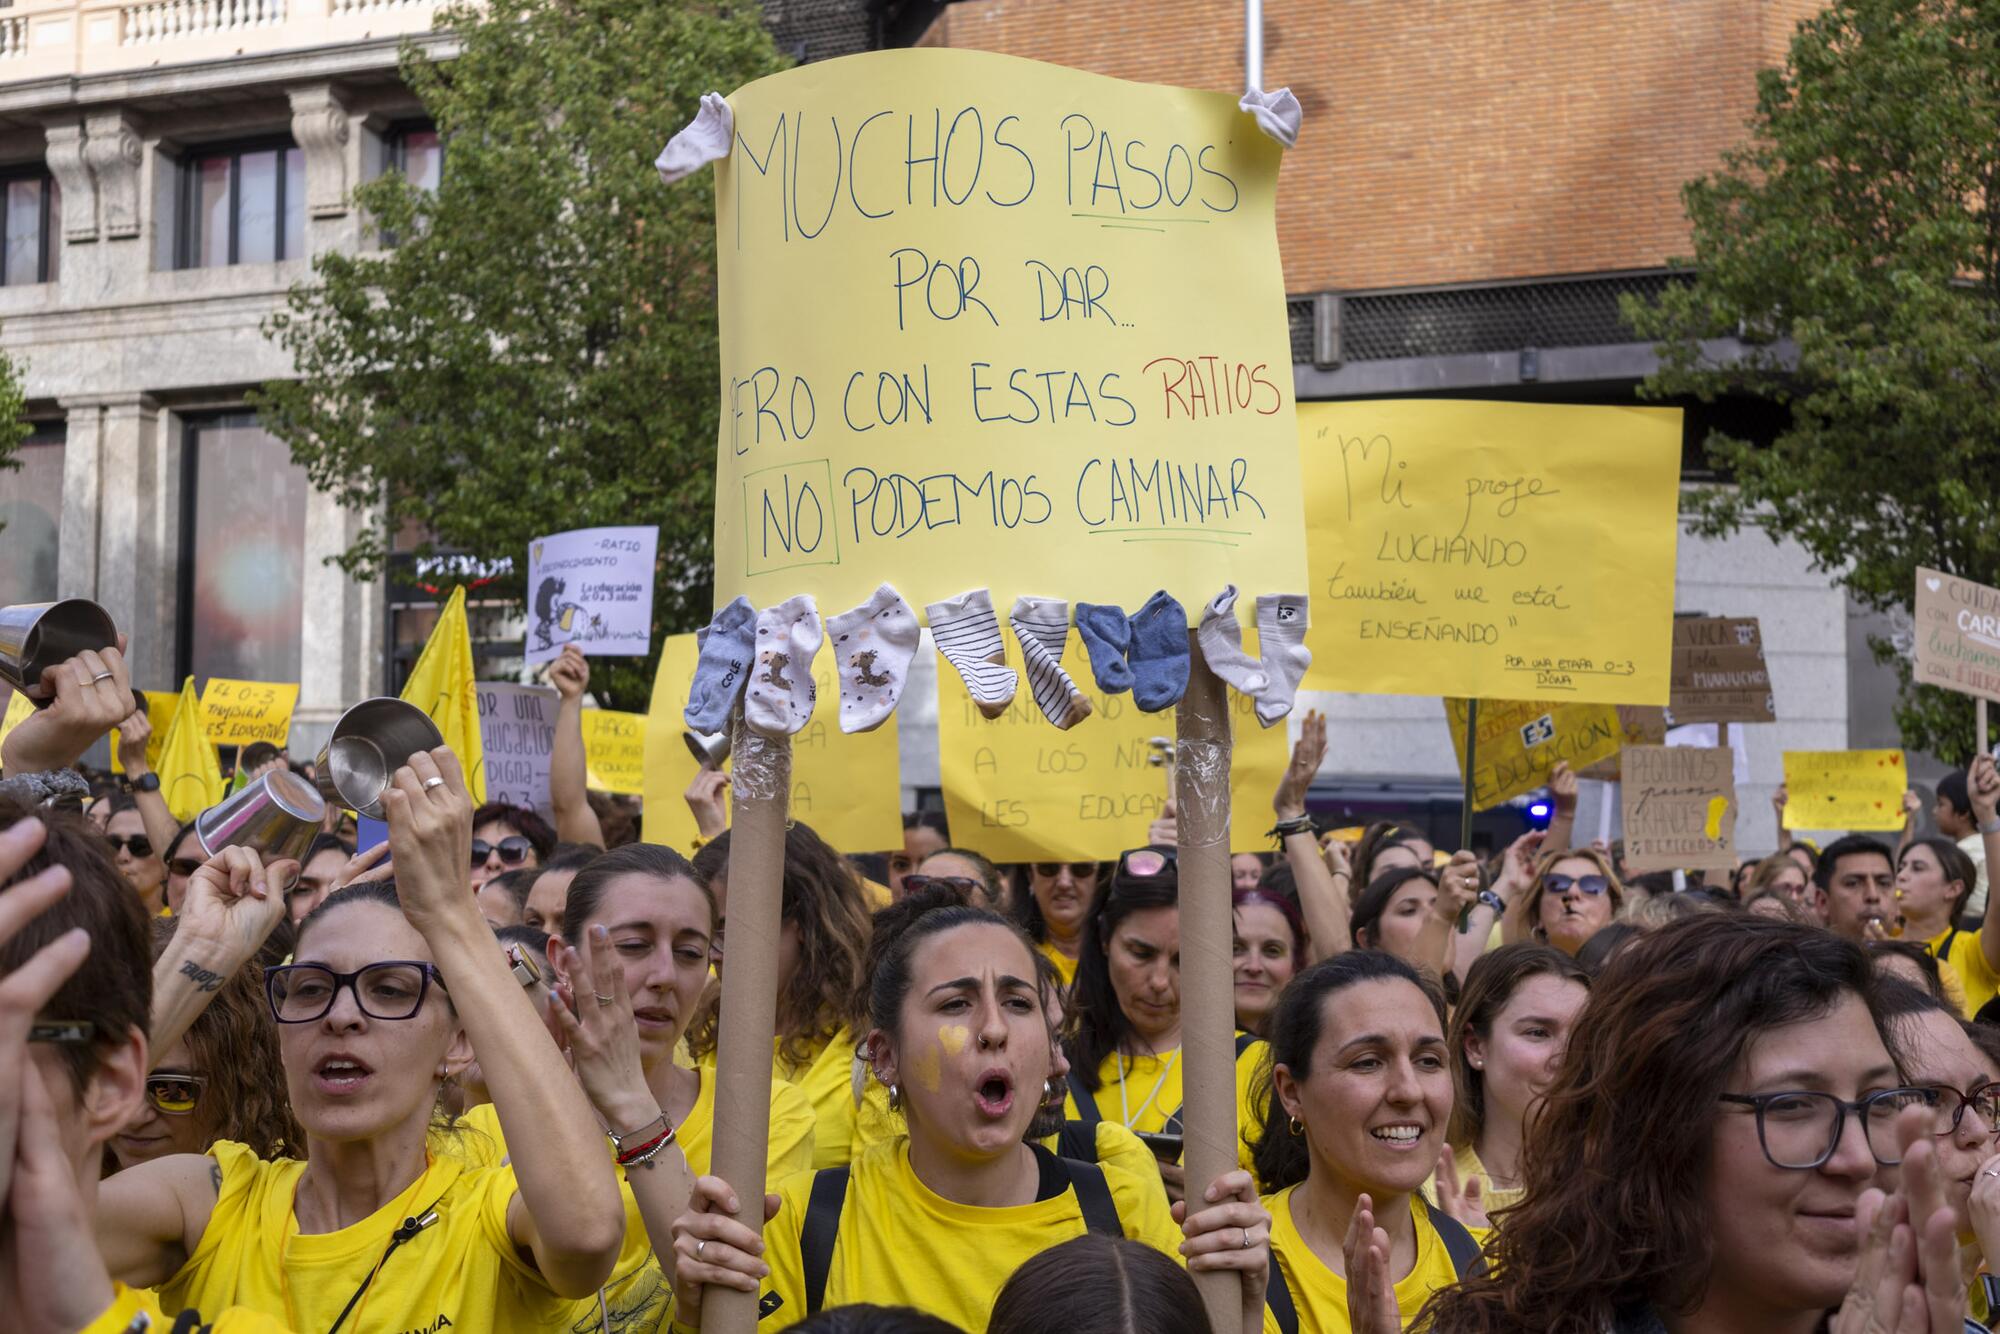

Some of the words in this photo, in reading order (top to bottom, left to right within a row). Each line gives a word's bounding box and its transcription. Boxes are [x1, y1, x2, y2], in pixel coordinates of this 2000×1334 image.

[736, 106, 1035, 250] MUCHOS
[1060, 113, 1239, 213] PASOS
[889, 248, 999, 330] POR
[1025, 260, 1136, 328] DAR...
[843, 364, 932, 432] CON
[970, 363, 1137, 426] ESTAS
[1141, 356, 1281, 421] RATIOS
[763, 473, 824, 557] NO
[843, 466, 1053, 543] PODEMOS
[1076, 457, 1266, 527] CAMINAR
[1376, 530, 1527, 569] LUCHANDO
[1454, 585, 1490, 604] me
[1512, 584, 1571, 610] está
[721, 658, 742, 689] COLE
[1037, 742, 1088, 774] LOS
[981, 799, 1029, 828] LES
